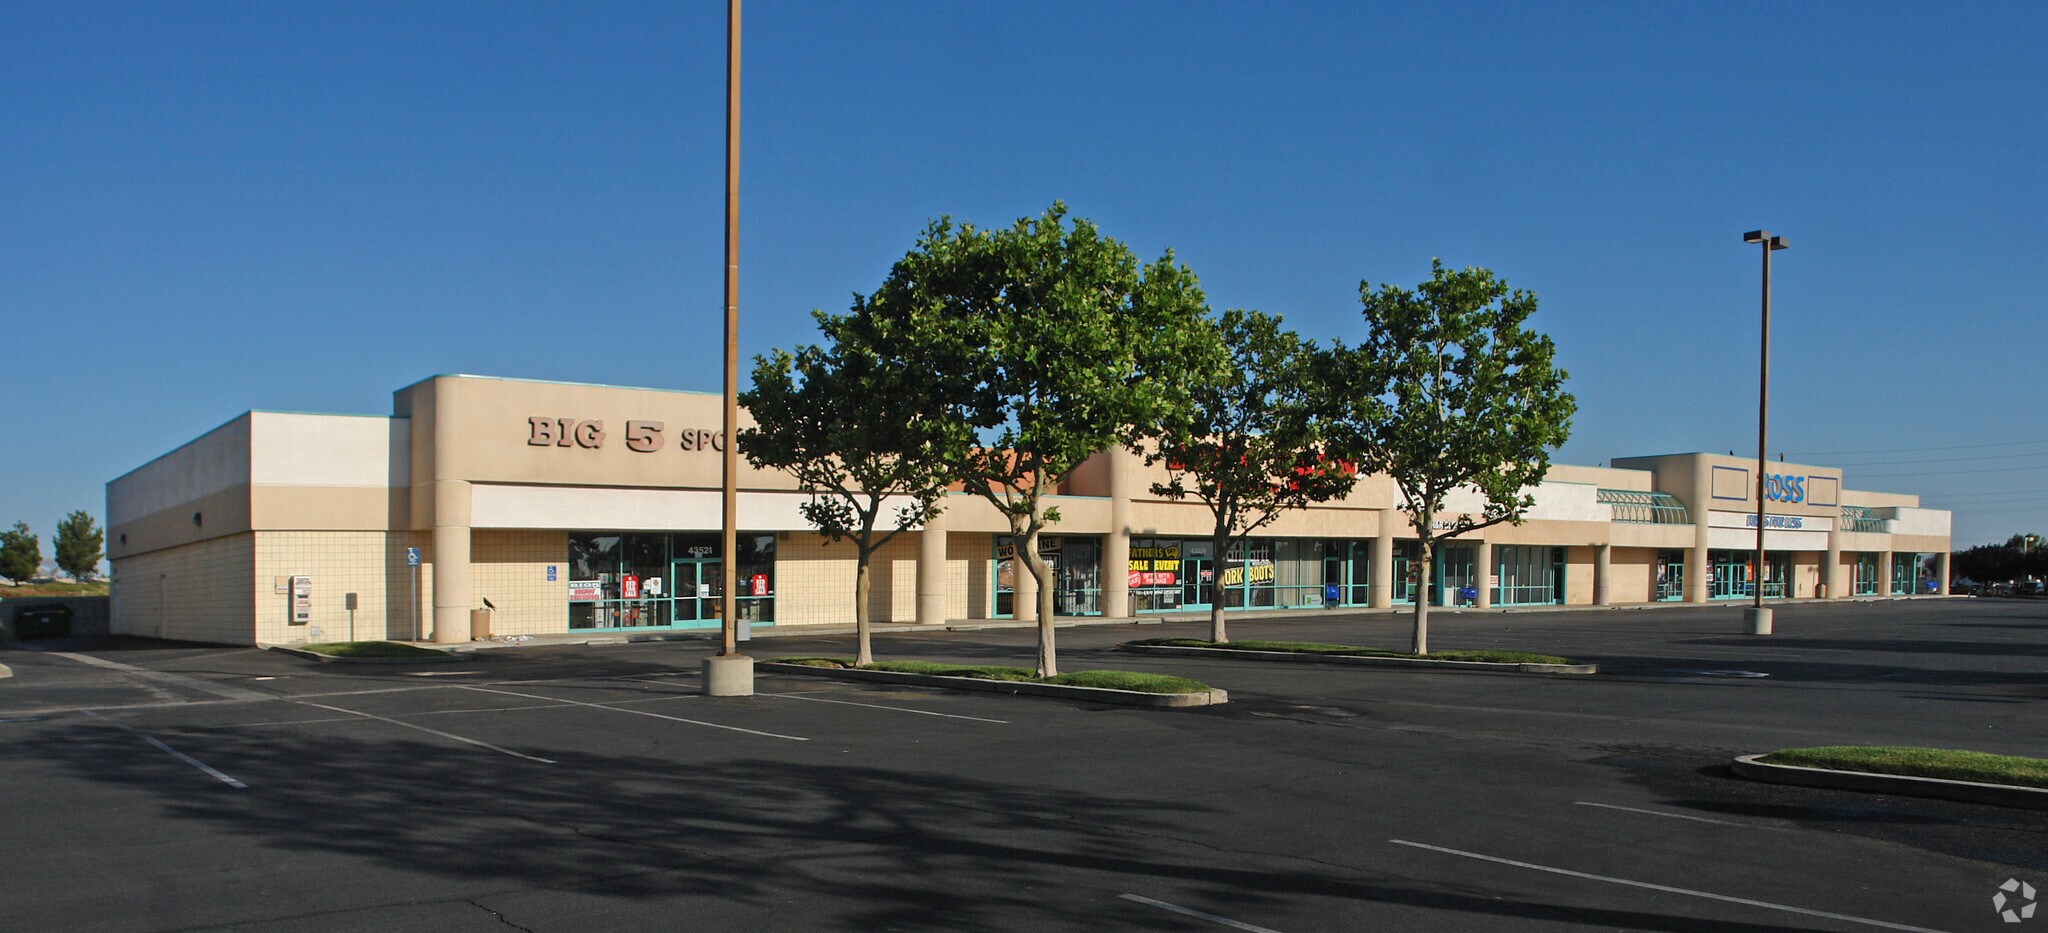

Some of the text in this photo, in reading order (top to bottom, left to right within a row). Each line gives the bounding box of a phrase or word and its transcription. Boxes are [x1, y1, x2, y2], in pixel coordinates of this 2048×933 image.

[528, 416, 606, 449] BIG
[626, 420, 665, 453] 5
[688, 546, 713, 555] 43521
[1129, 560, 1179, 570] SALE EVENT
[1225, 569, 1243, 585] ORK
[1249, 565, 1274, 582] BOOTS
